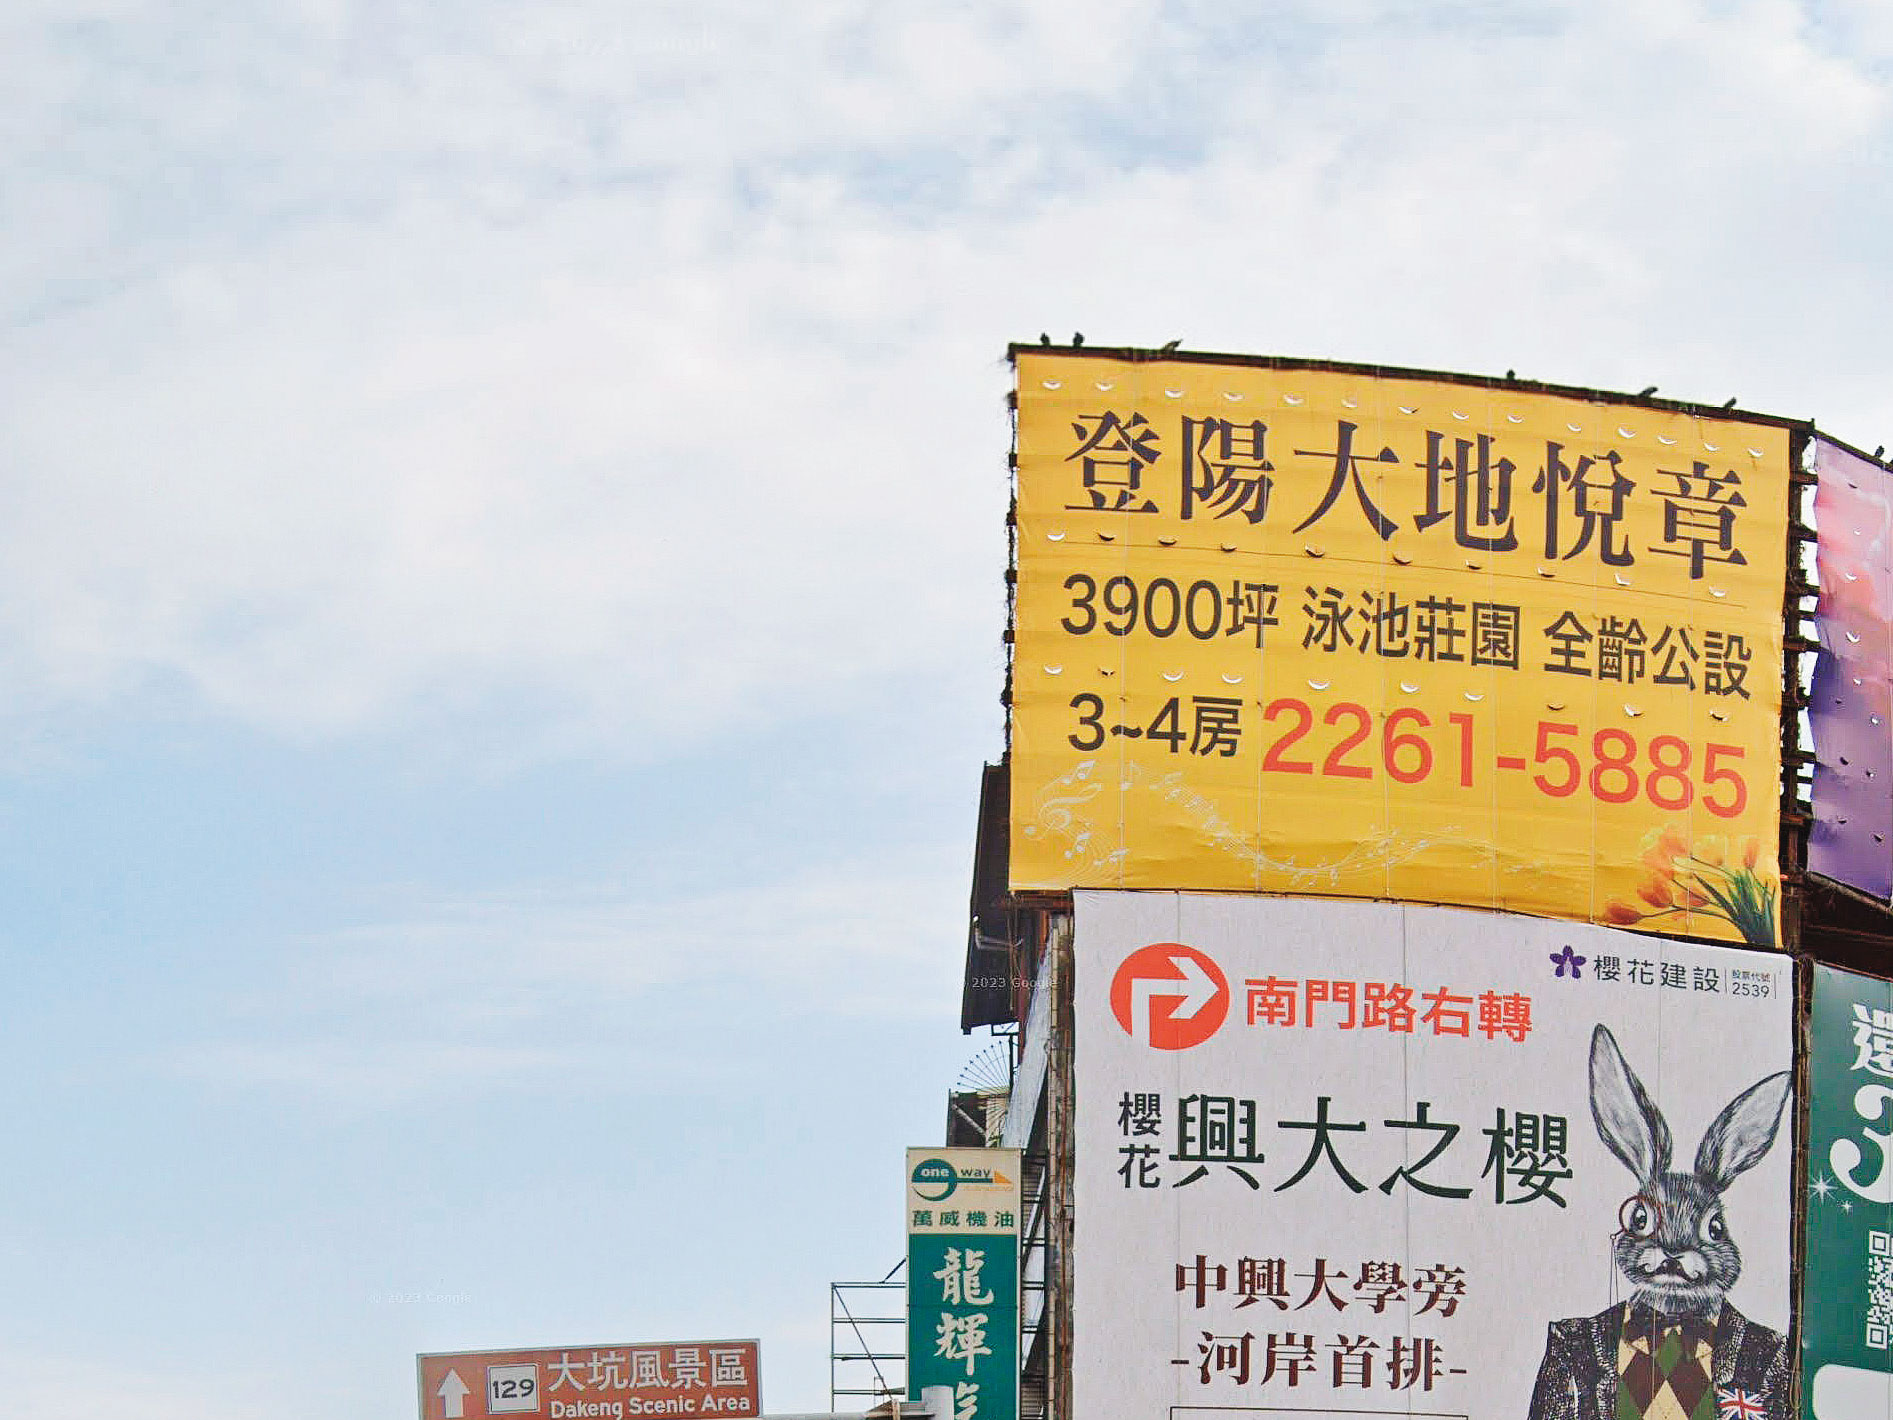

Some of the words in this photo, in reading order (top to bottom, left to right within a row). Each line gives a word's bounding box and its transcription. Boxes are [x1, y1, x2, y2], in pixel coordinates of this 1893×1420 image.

[1063, 412, 1748, 579] 登陽大地悅章
[1061, 574, 1280, 649] 3900坪
[1301, 586, 1521, 671] 泳池莊園
[1543, 611, 1752, 701] 全齡公設
[1067, 693, 1244, 757] 3~4房
[1262, 697, 1748, 818] 2261-5885
[1593, 954, 1720, 993] 櫻花建設
[1732, 983, 1771, 998] 2539
[1244, 976, 1533, 1043] 南門路右轉
[921, 1168, 950, 1177] one
[960, 1166, 991, 1178] way
[1117, 1091, 1162, 1190] 櫻花
[1168, 1093, 1573, 1208] 興大之櫻
[1174, 1253, 1467, 1319] 中興大學旁
[492, 1376, 535, 1399] 129
[548, 1347, 748, 1393] 大坑風景區
[1170, 1329, 1467, 1392] -河岸首排-
[629, 1396, 696, 1416] Scenic
[701, 1394, 750, 1412] Area
